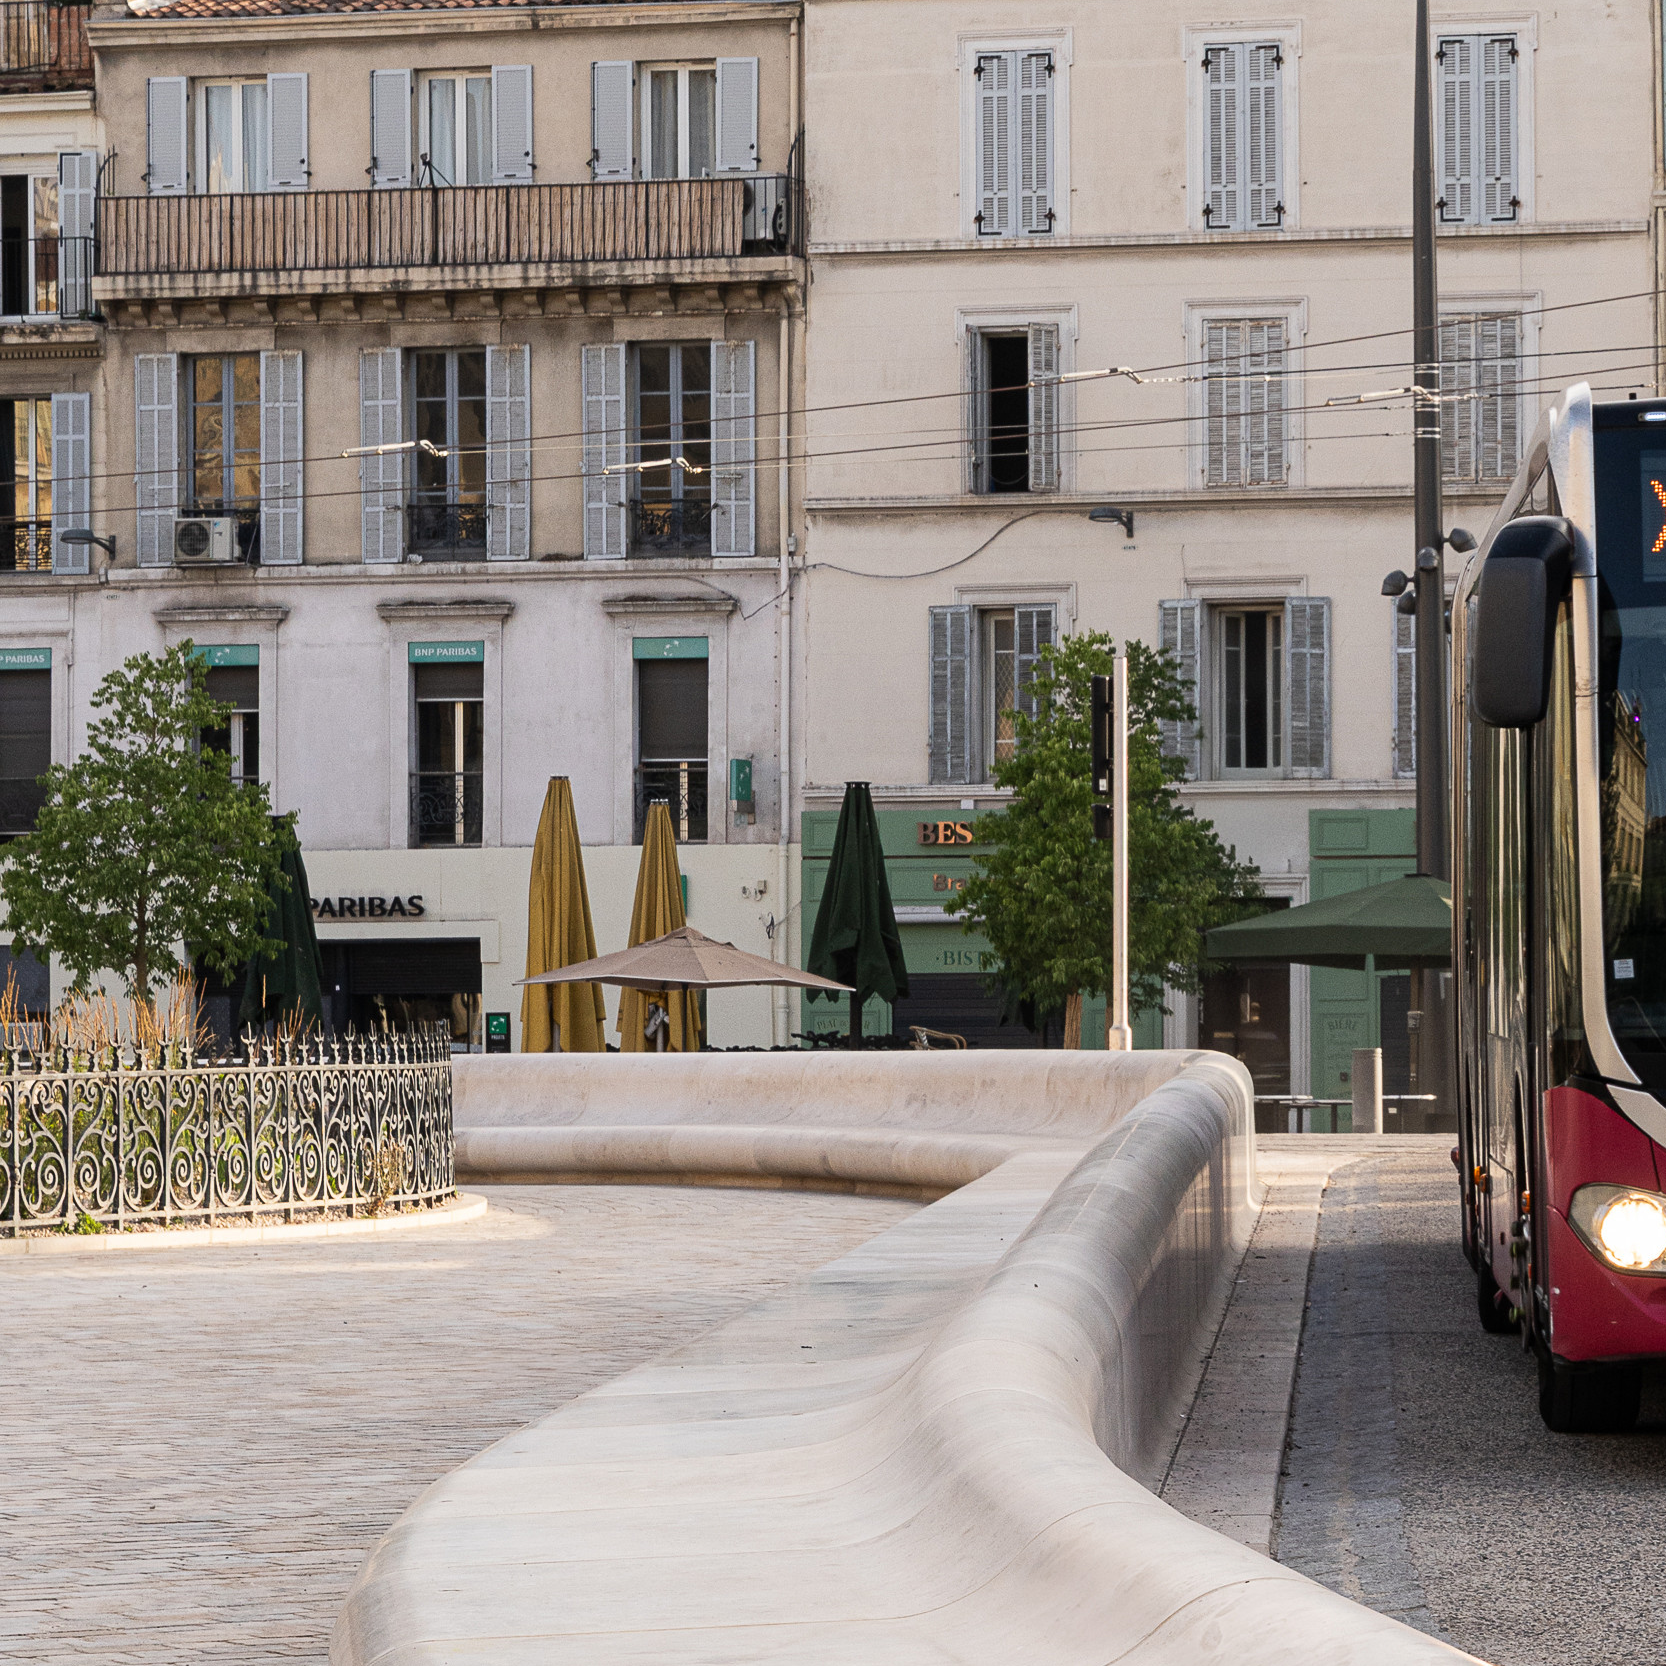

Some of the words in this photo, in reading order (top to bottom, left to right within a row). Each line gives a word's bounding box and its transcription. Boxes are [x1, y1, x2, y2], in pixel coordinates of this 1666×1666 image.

[414, 648, 435, 657] BNP
[436, 647, 477, 656] PARIBAS
[5, 654, 46, 663] PARIBAS
[917, 821, 977, 845] BES
